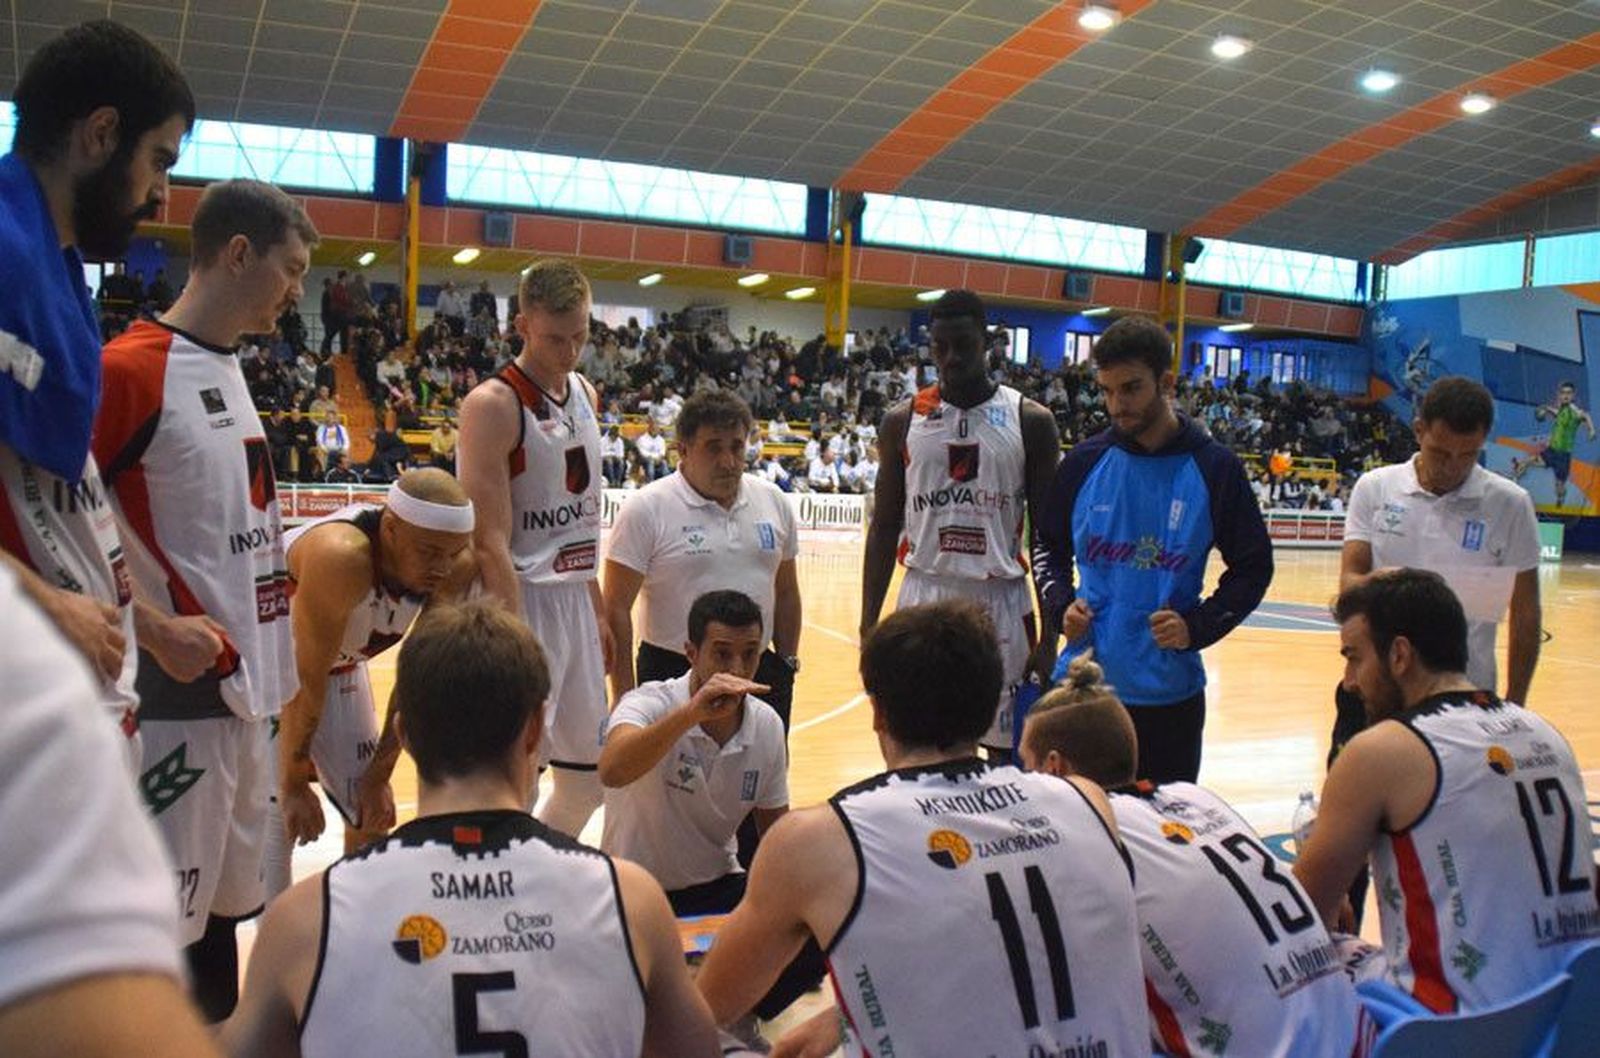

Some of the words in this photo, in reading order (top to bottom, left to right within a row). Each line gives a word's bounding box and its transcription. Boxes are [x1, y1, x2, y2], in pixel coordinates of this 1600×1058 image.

[800, 496, 862, 530] Opinión
[915, 782, 1029, 816] MENDIKOTE
[974, 828, 1061, 859] ZAMORANO
[1515, 776, 1592, 898] 12
[430, 869, 515, 900] SAMAR
[1200, 832, 1316, 947] 13
[451, 931, 556, 955] ZAMORANO
[985, 865, 1077, 1031] 11
[451, 970, 530, 1058] 5
